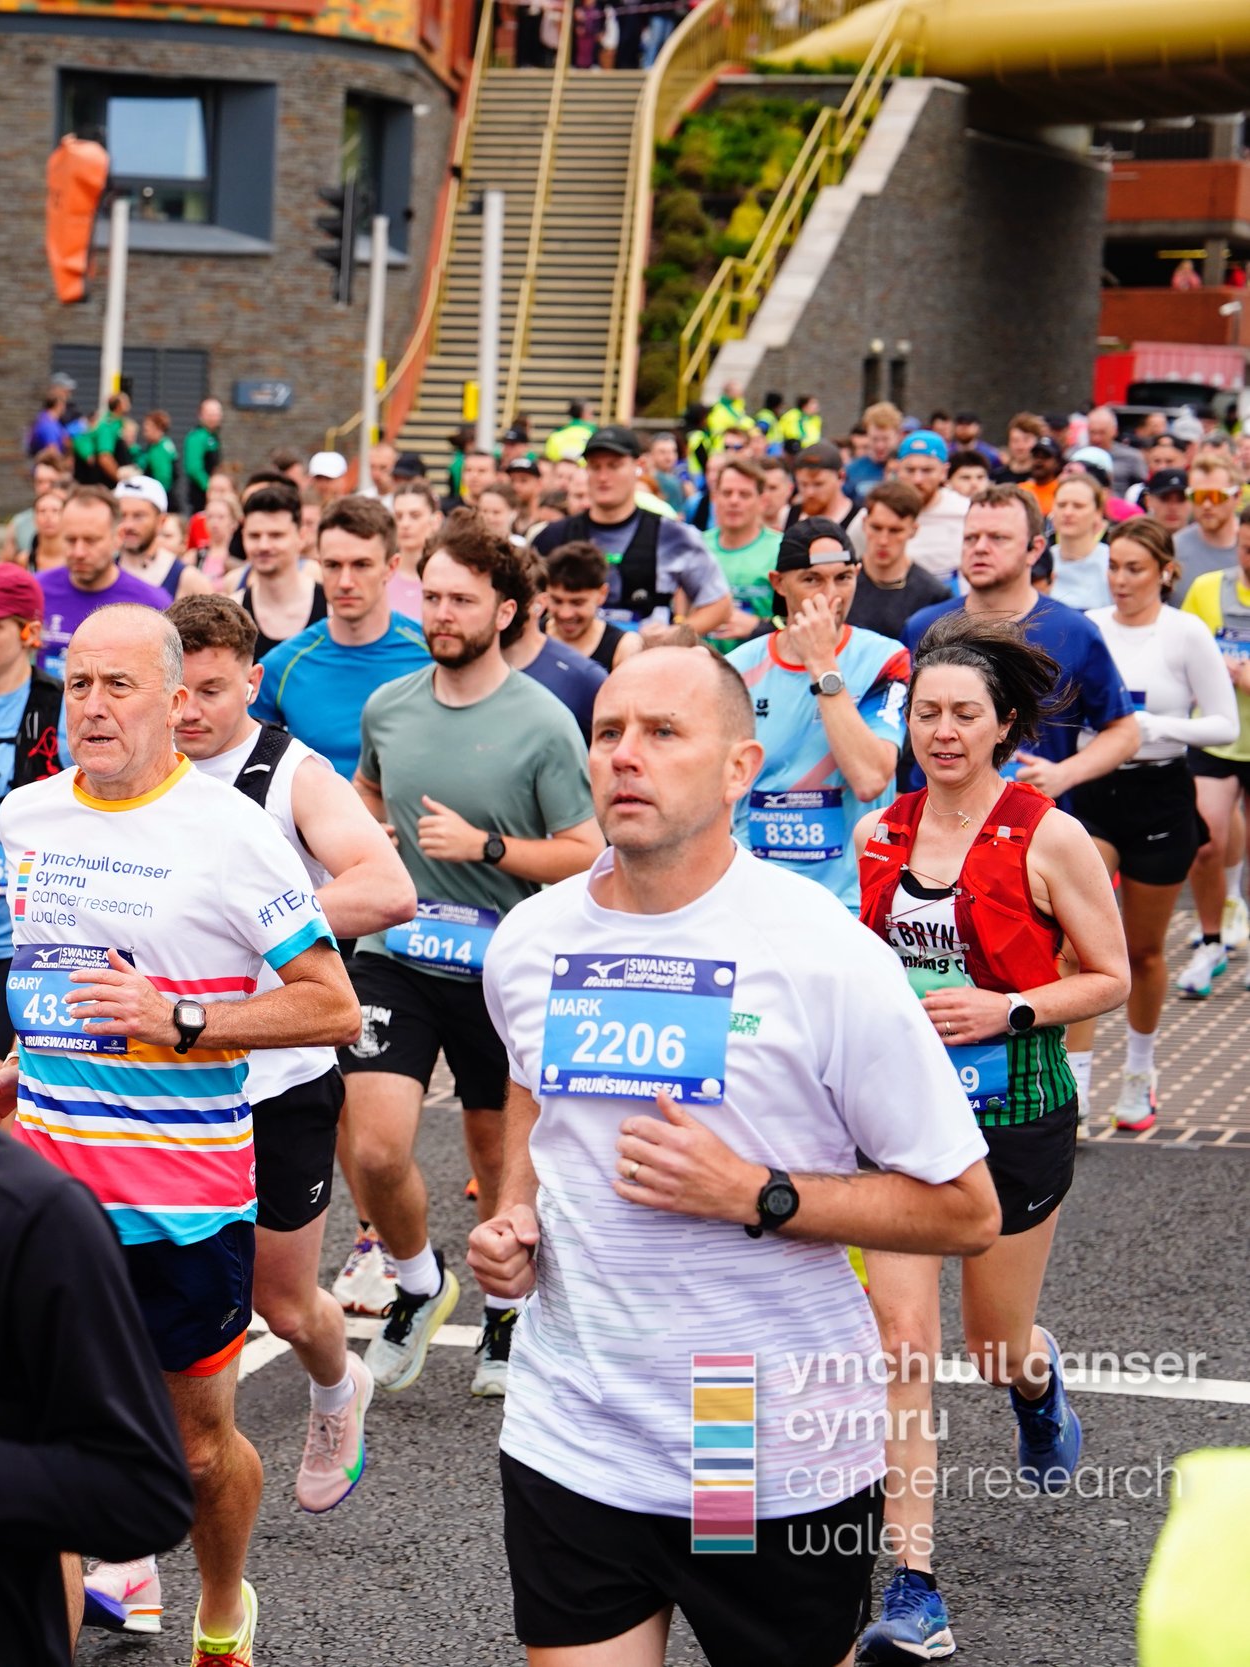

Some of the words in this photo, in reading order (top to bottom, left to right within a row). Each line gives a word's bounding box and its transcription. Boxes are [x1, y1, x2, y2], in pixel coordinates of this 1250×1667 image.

[750, 811, 803, 822] JONATHAN
[766, 823, 825, 845] 8338
[41, 851, 109, 872] ymchwil
[112, 860, 172, 880] canser
[36, 871, 86, 888] cymru
[32, 890, 84, 907] cancer
[83, 897, 153, 918] research
[31, 909, 76, 927] wales
[897, 921, 954, 950] BRYN
[62, 947, 108, 961] SWANSEA
[407, 933, 472, 964] 5014
[629, 958, 695, 976] SWANSEA
[8, 977, 42, 990] GARY
[550, 998, 602, 1017] MARK
[25, 1036, 97, 1051] #RUNSWANSEA
[572, 1020, 686, 1069] 2206
[568, 1077, 683, 1100] #RUNSWANSEA
